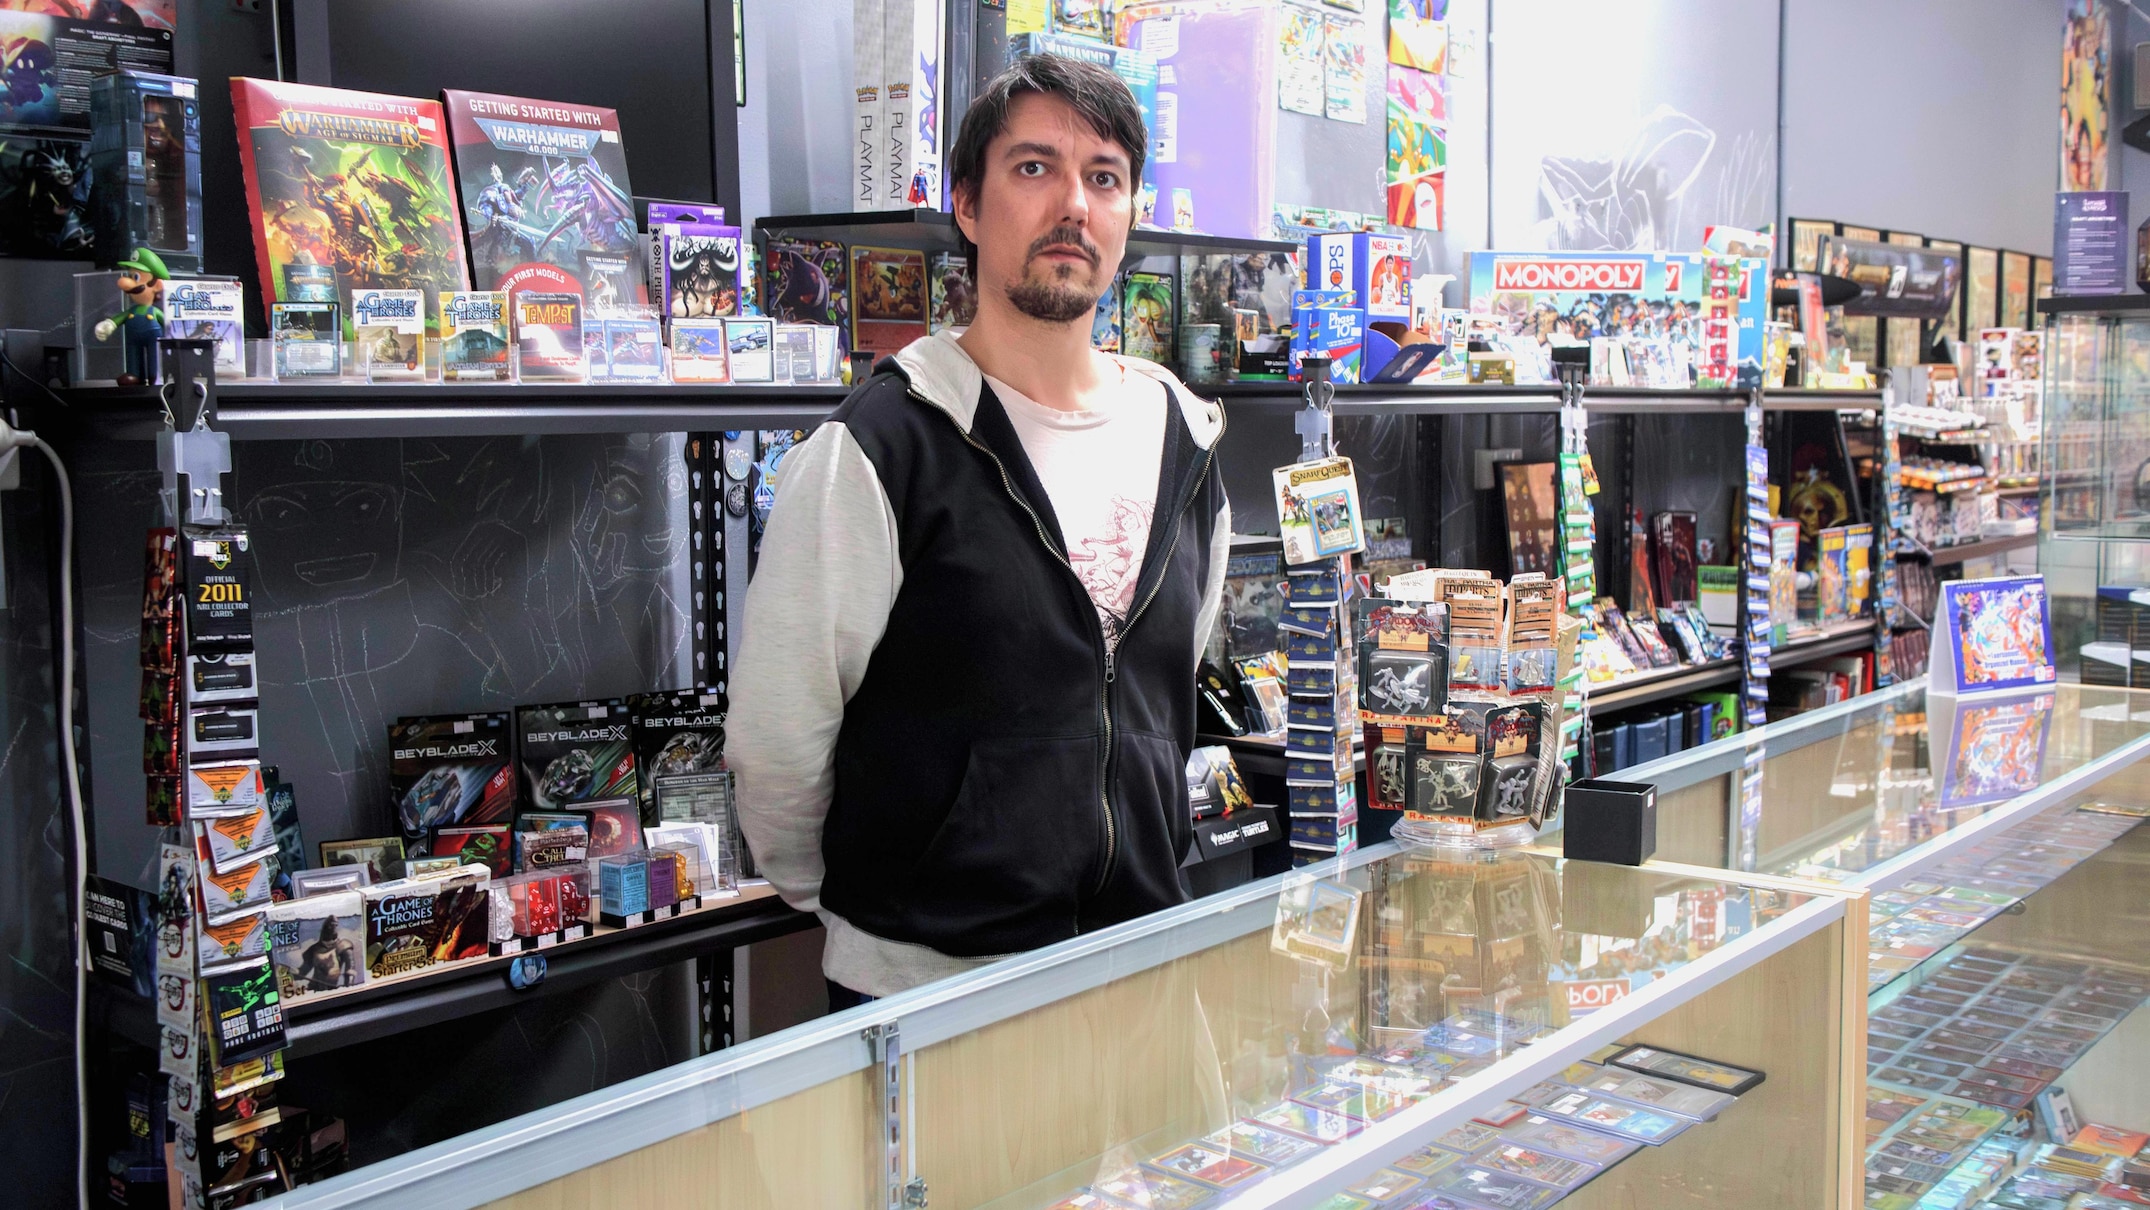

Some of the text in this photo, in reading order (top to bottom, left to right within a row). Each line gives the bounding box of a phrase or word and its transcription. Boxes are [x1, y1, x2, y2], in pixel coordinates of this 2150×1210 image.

[385, 104, 418, 116] WITH
[469, 99, 601, 126] GETTING STARTED WITH
[281, 112, 416, 145] WARHAMMER
[317, 129, 338, 137] AGE
[353, 132, 394, 144] SIGMAR
[492, 125, 588, 150] WARHAMMER
[860, 116, 872, 206] PLAYMAT
[891, 112, 904, 203] PLAYMAT
[1372, 241, 1388, 251] NBA
[514, 269, 534, 283] FIRST
[536, 268, 565, 284] MODELS
[1499, 264, 1642, 288] MONOPOLY
[364, 292, 404, 309] GAME
[452, 296, 490, 312] GAME
[356, 308, 416, 324] THRONES
[445, 311, 500, 327] THRONES
[1329, 312, 1356, 326] Phase
[1335, 323, 1350, 338] 10
[199, 584, 242, 602] 2011
[645, 715, 721, 728] BEYBLADE
[527, 724, 628, 742] BEYBLADE X
[394, 739, 497, 760] BEYBLADE X
[1217, 829, 1240, 841] MAGIC
[1242, 824, 1269, 837] TURTLES
[100, 894, 116, 907] HERE
[116, 899, 125, 910] TO
[371, 895, 433, 916] A GAME OF
[110, 918, 128, 930] CARDS
[288, 921, 299, 930] OF
[372, 906, 433, 936] THRONES
[384, 925, 407, 933] Collectible
[372, 957, 436, 979] Starter Set
[283, 983, 306, 999] Set
[248, 1024, 283, 1040] FOOTBALL
